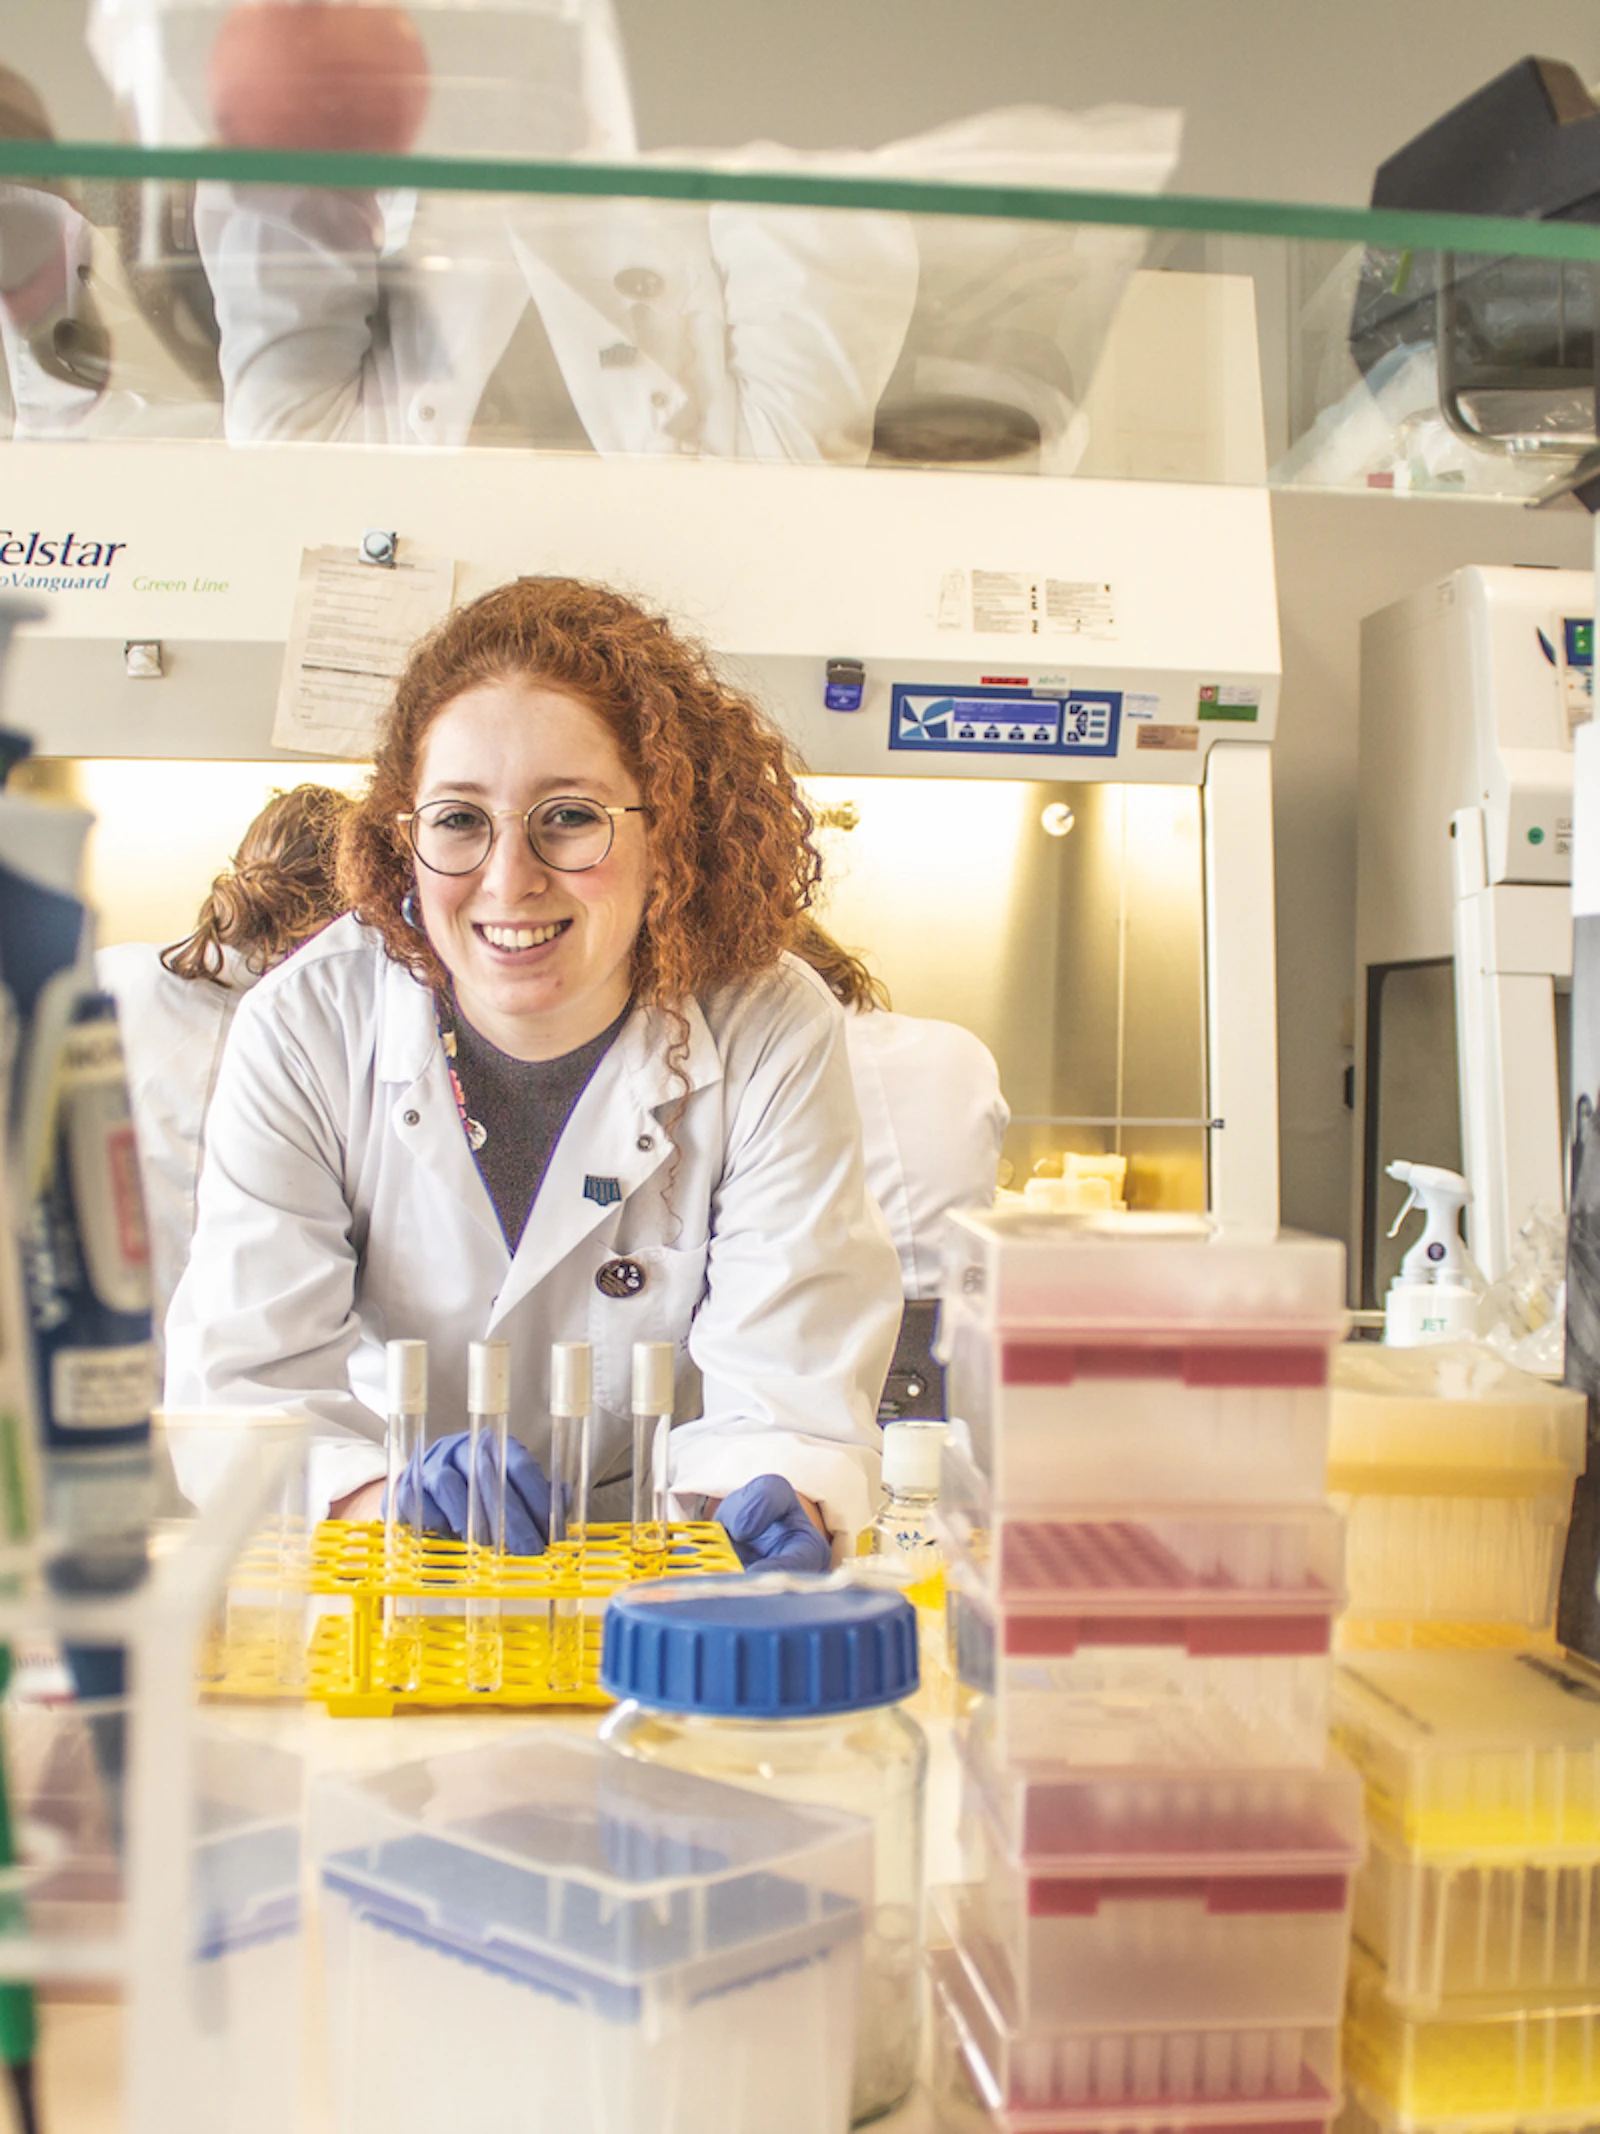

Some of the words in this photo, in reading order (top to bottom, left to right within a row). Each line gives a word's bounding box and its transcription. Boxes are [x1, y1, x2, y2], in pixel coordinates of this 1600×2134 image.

[132, 575, 187, 592] Green
[193, 577, 229, 592] Line
[1420, 1317, 1448, 1332] JET
